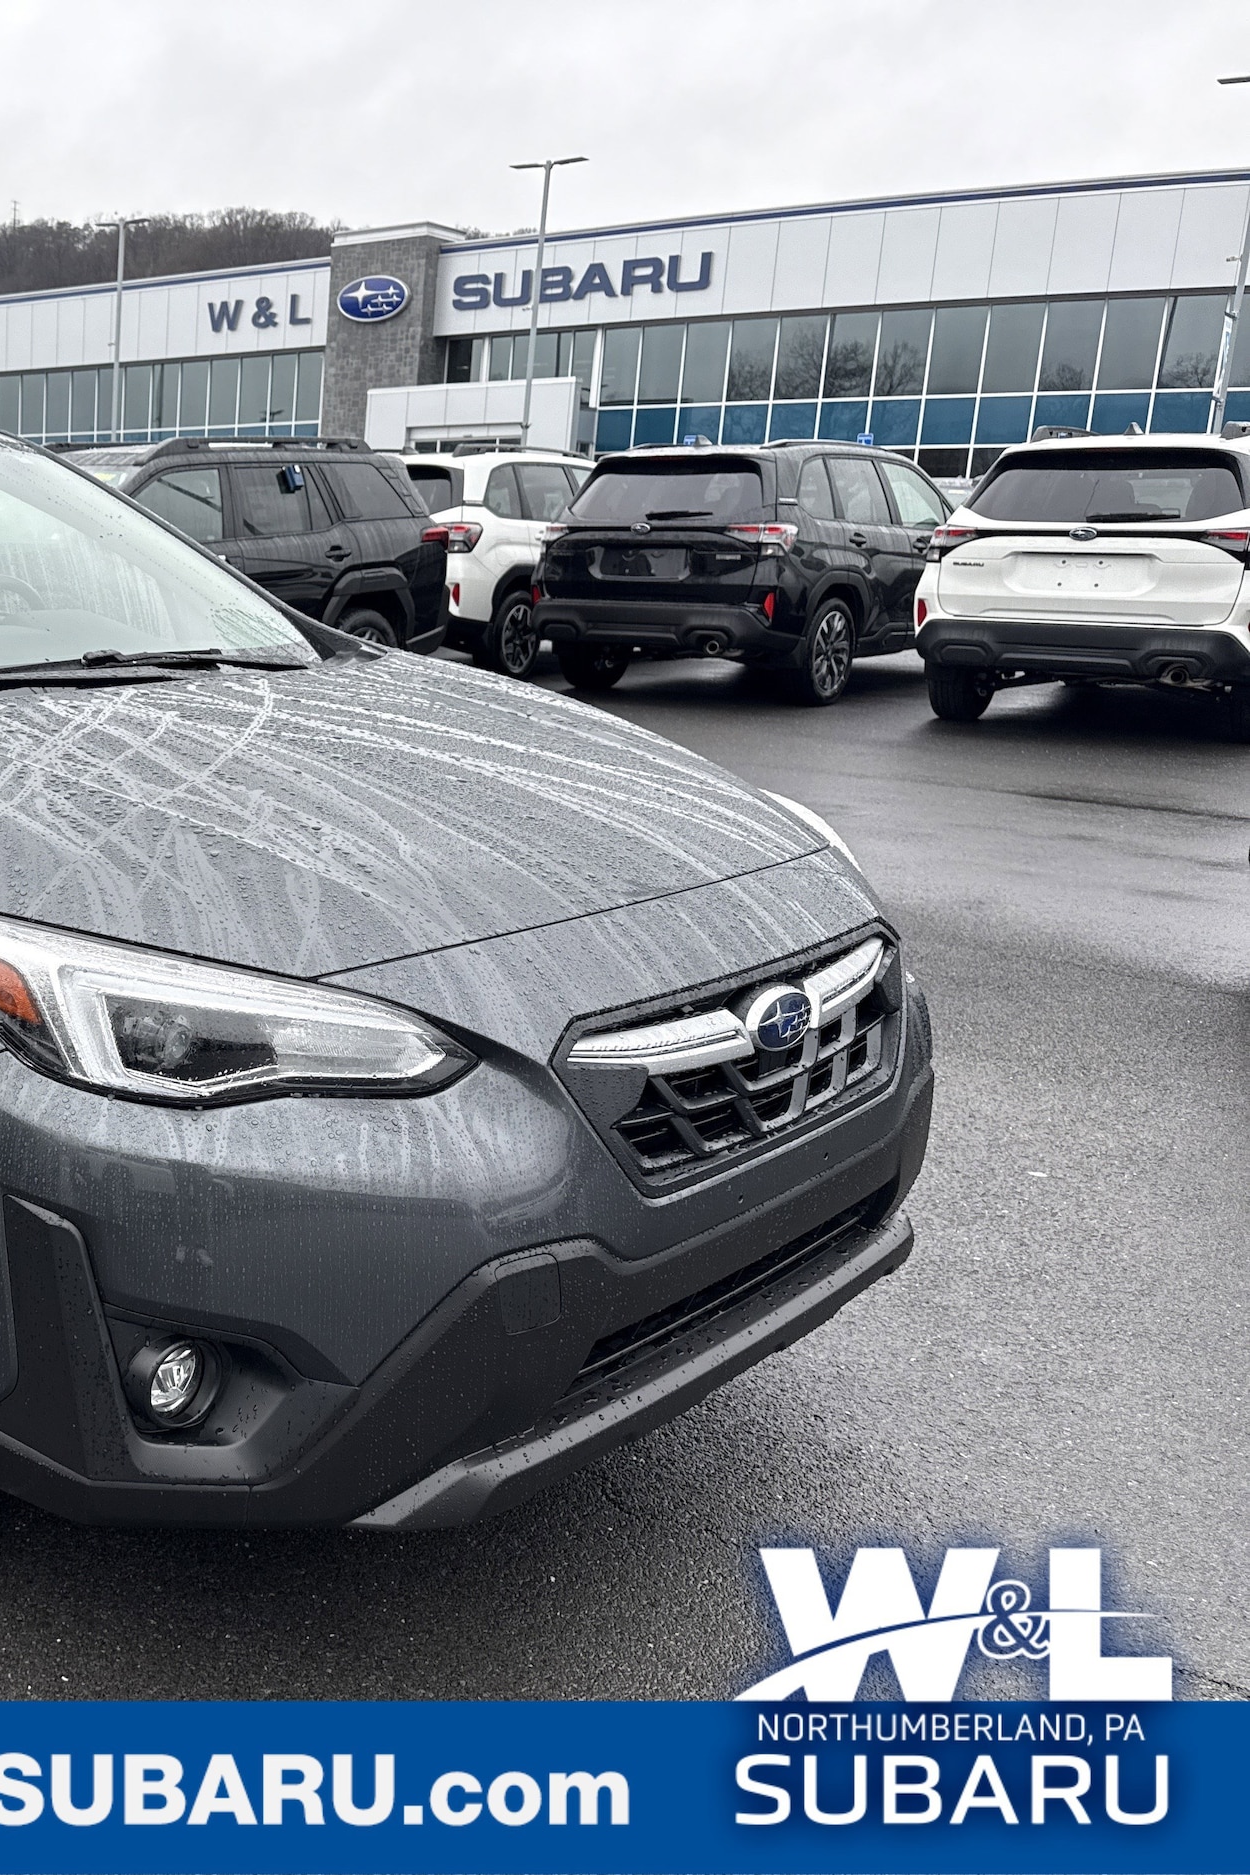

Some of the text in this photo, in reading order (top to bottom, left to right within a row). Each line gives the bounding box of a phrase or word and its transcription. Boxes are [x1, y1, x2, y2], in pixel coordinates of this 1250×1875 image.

[452, 251, 713, 311] SUBARU
[208, 294, 312, 333] W & L
